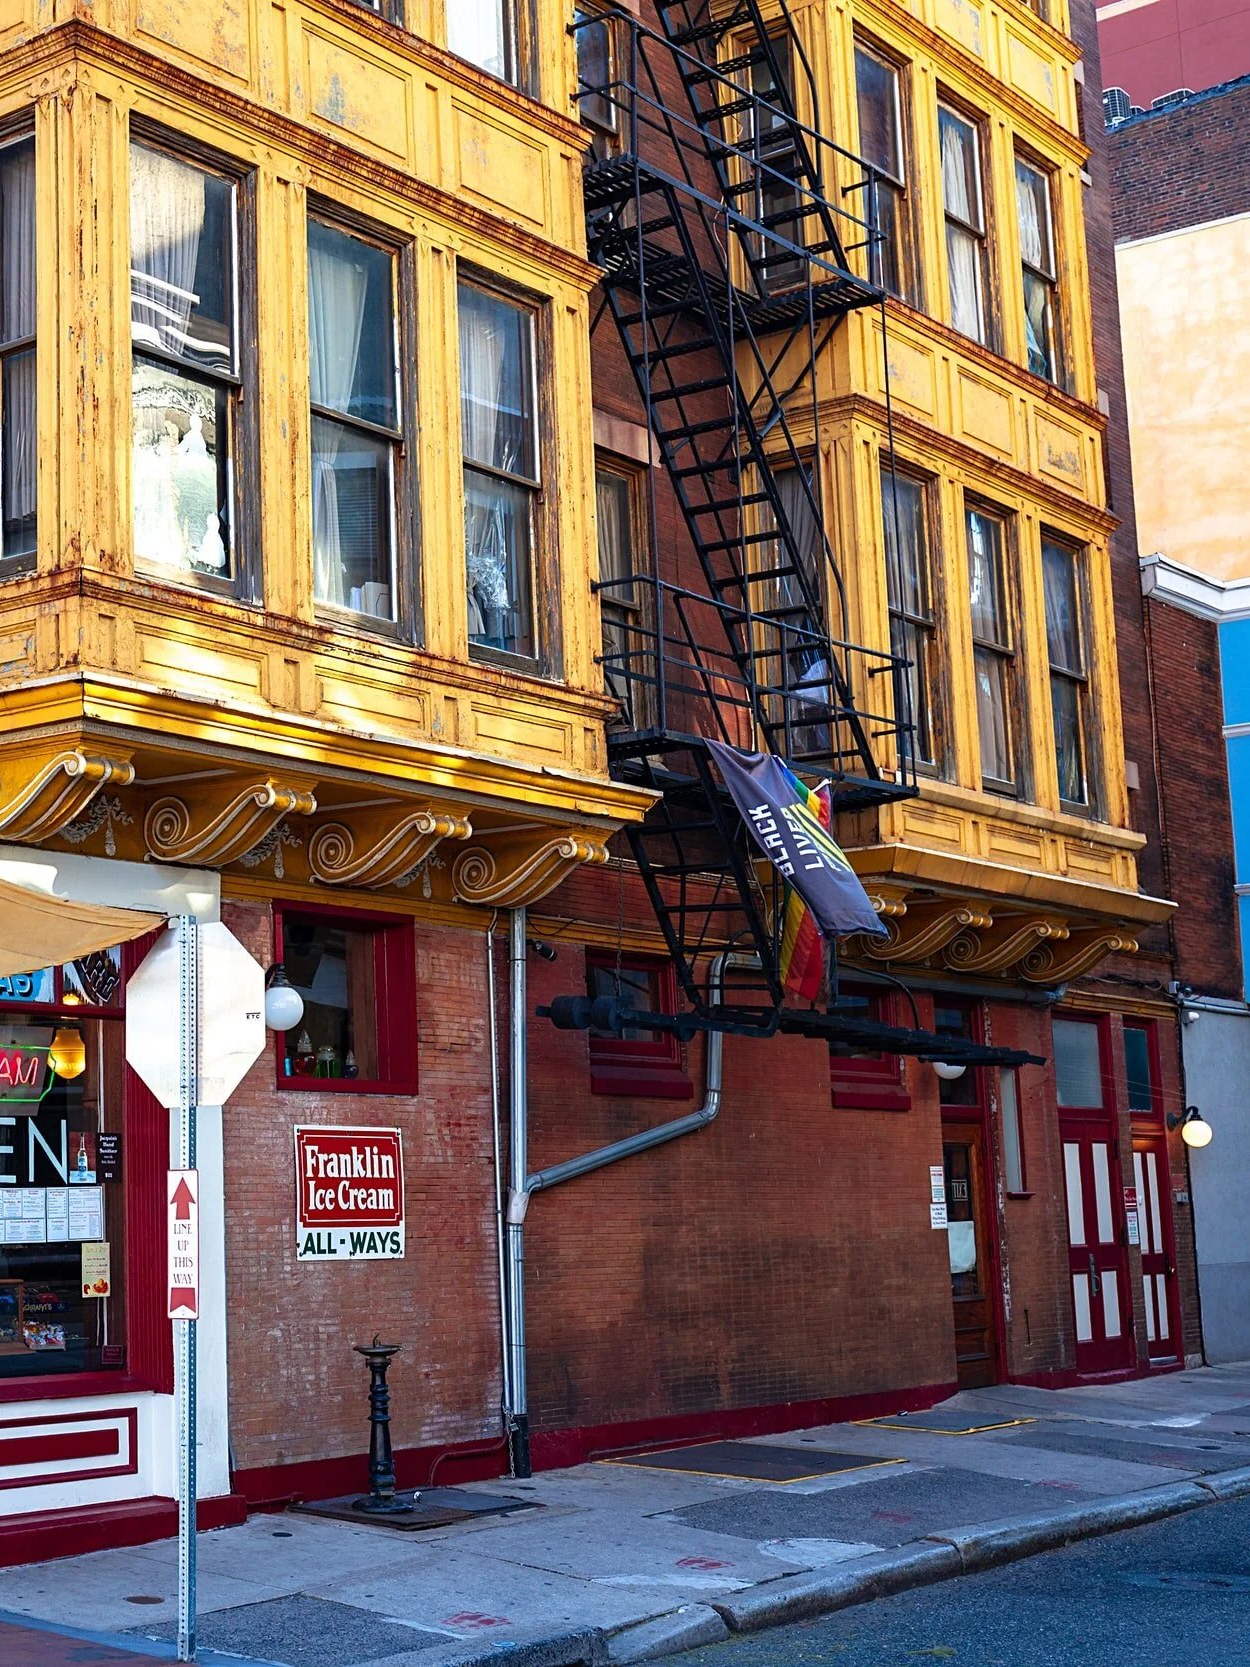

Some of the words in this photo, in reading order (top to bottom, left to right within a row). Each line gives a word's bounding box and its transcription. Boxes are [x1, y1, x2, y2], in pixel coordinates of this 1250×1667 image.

[748, 803, 795, 877] BLACK
[304, 1145, 395, 1178] Franklin
[308, 1180, 335, 1210] Ice
[337, 1180, 394, 1210] Cream
[173, 1223, 193, 1235] LINE
[177, 1240, 189, 1251] UP
[173, 1257, 193, 1268] THIS
[173, 1274, 193, 1285] WAY
